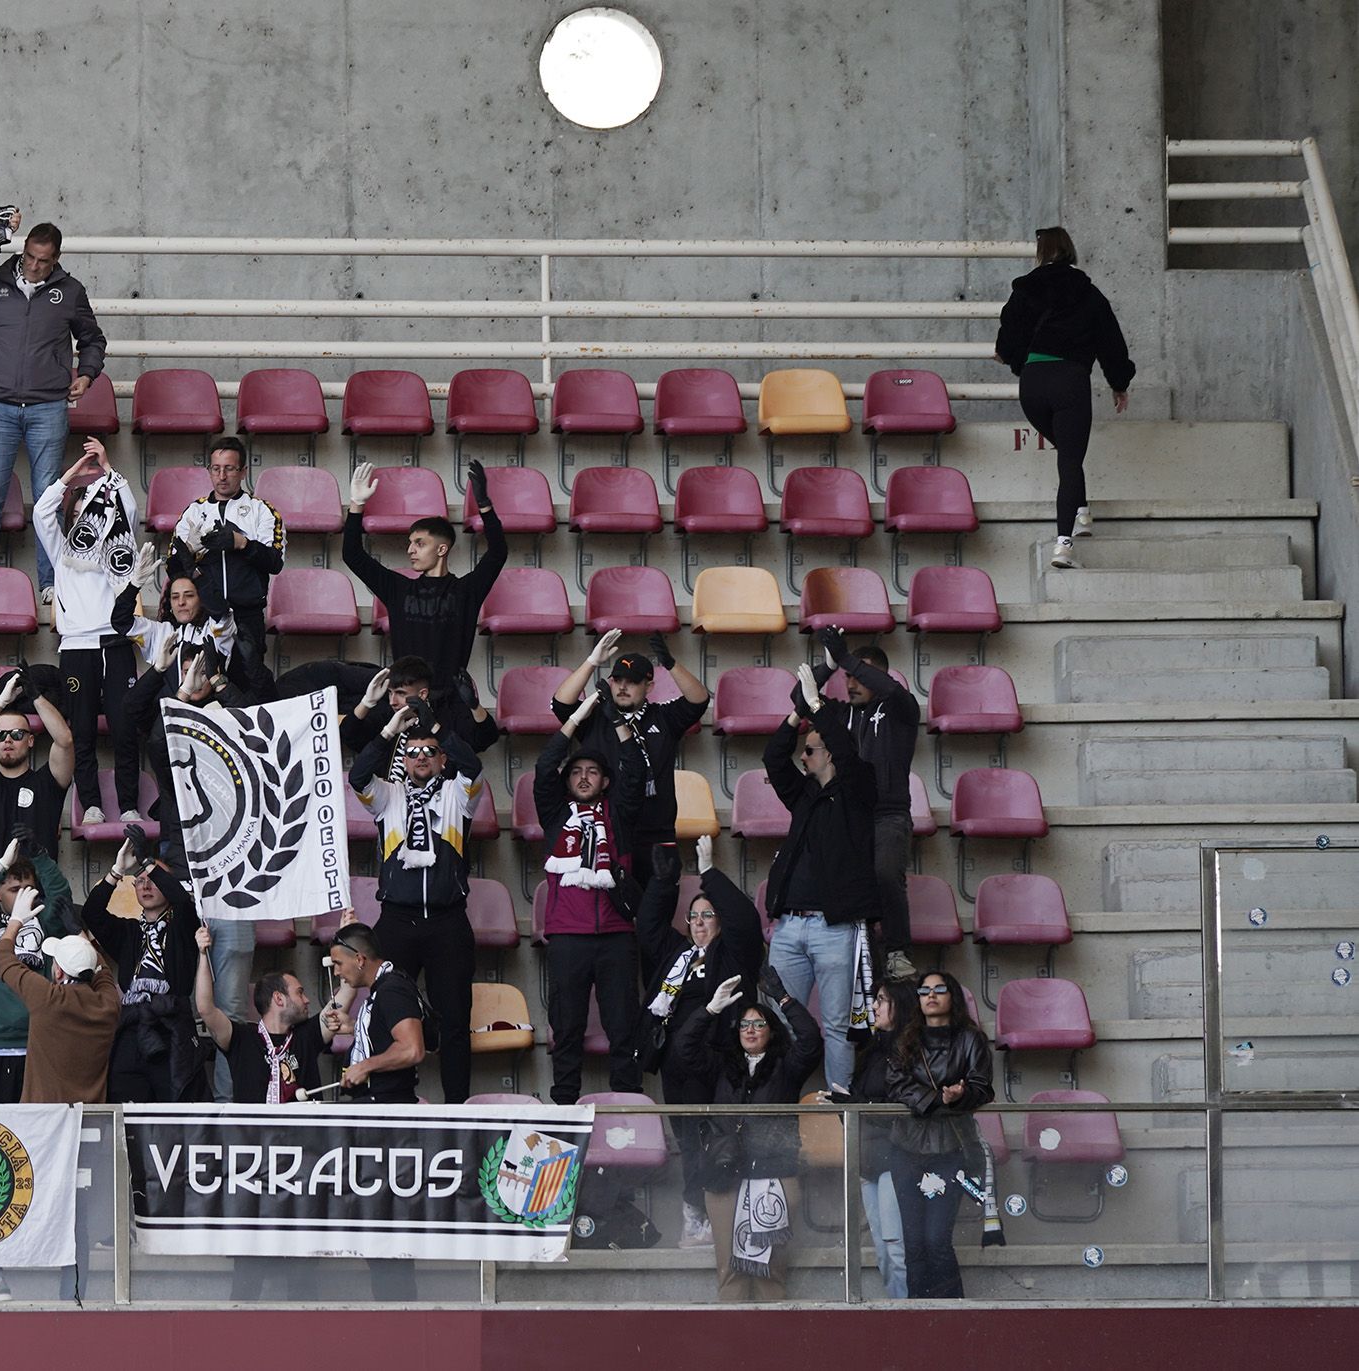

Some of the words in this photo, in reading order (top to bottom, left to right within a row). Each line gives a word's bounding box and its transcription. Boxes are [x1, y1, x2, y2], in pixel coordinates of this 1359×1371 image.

[310, 691, 332, 798] FONDO
[317, 805, 344, 910] OESTE
[15, 1178, 33, 1190] 23
